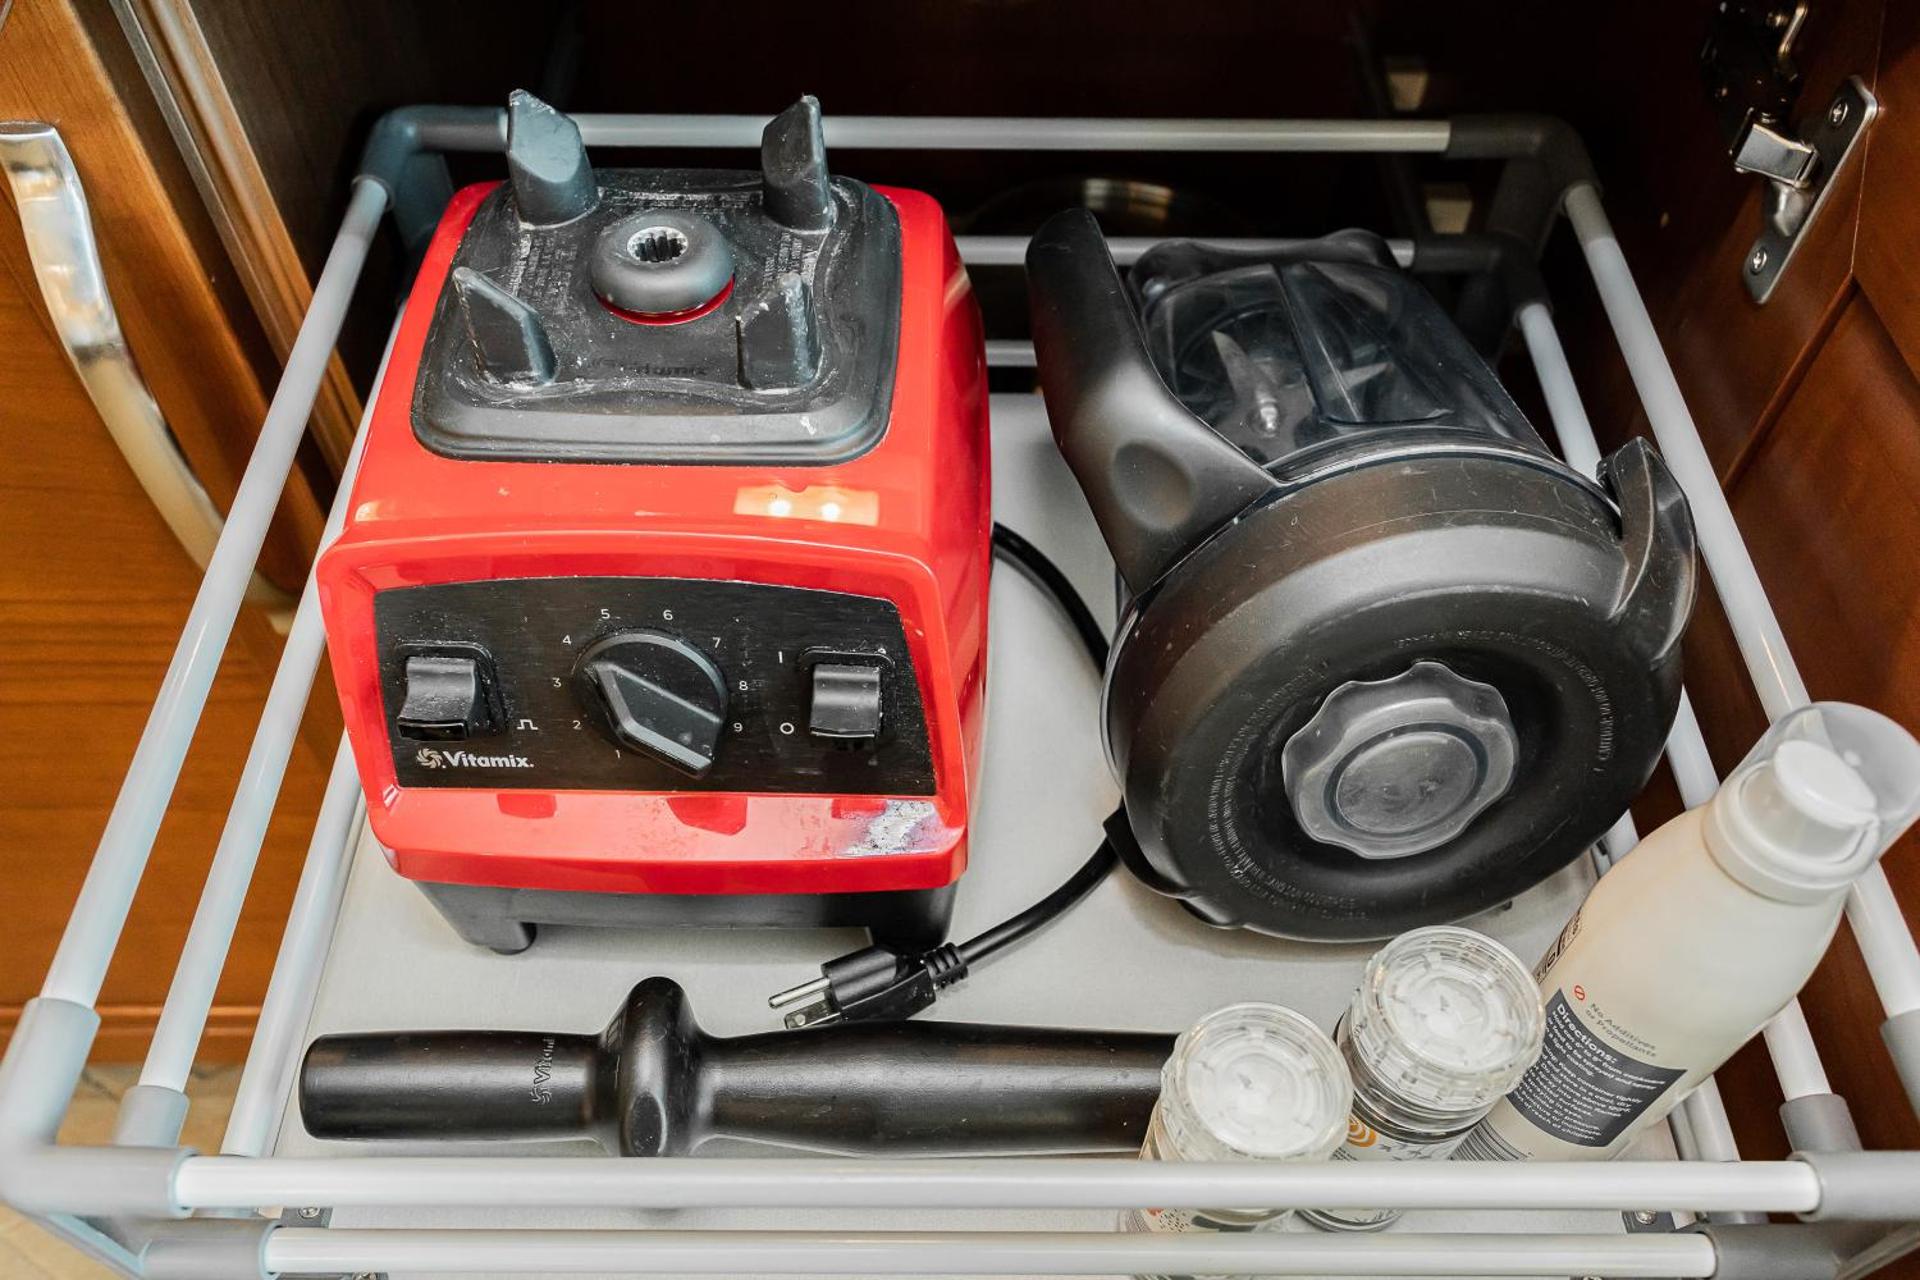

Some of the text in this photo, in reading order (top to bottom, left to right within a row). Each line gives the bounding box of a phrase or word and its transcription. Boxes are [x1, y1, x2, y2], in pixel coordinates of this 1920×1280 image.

[601, 608, 610, 620] 5
[663, 609, 674, 621] 6
[562, 634, 572, 646] 4
[712, 636, 721, 648] 7
[552, 677, 562, 688] 3
[739, 681, 748, 691] 8
[572, 719, 581, 731] 2
[733, 722, 743, 733] 9
[443, 750, 530, 768] Vitamix
[1591, 1002, 1605, 1018] No
[1557, 1003, 1617, 1064] Directions:
